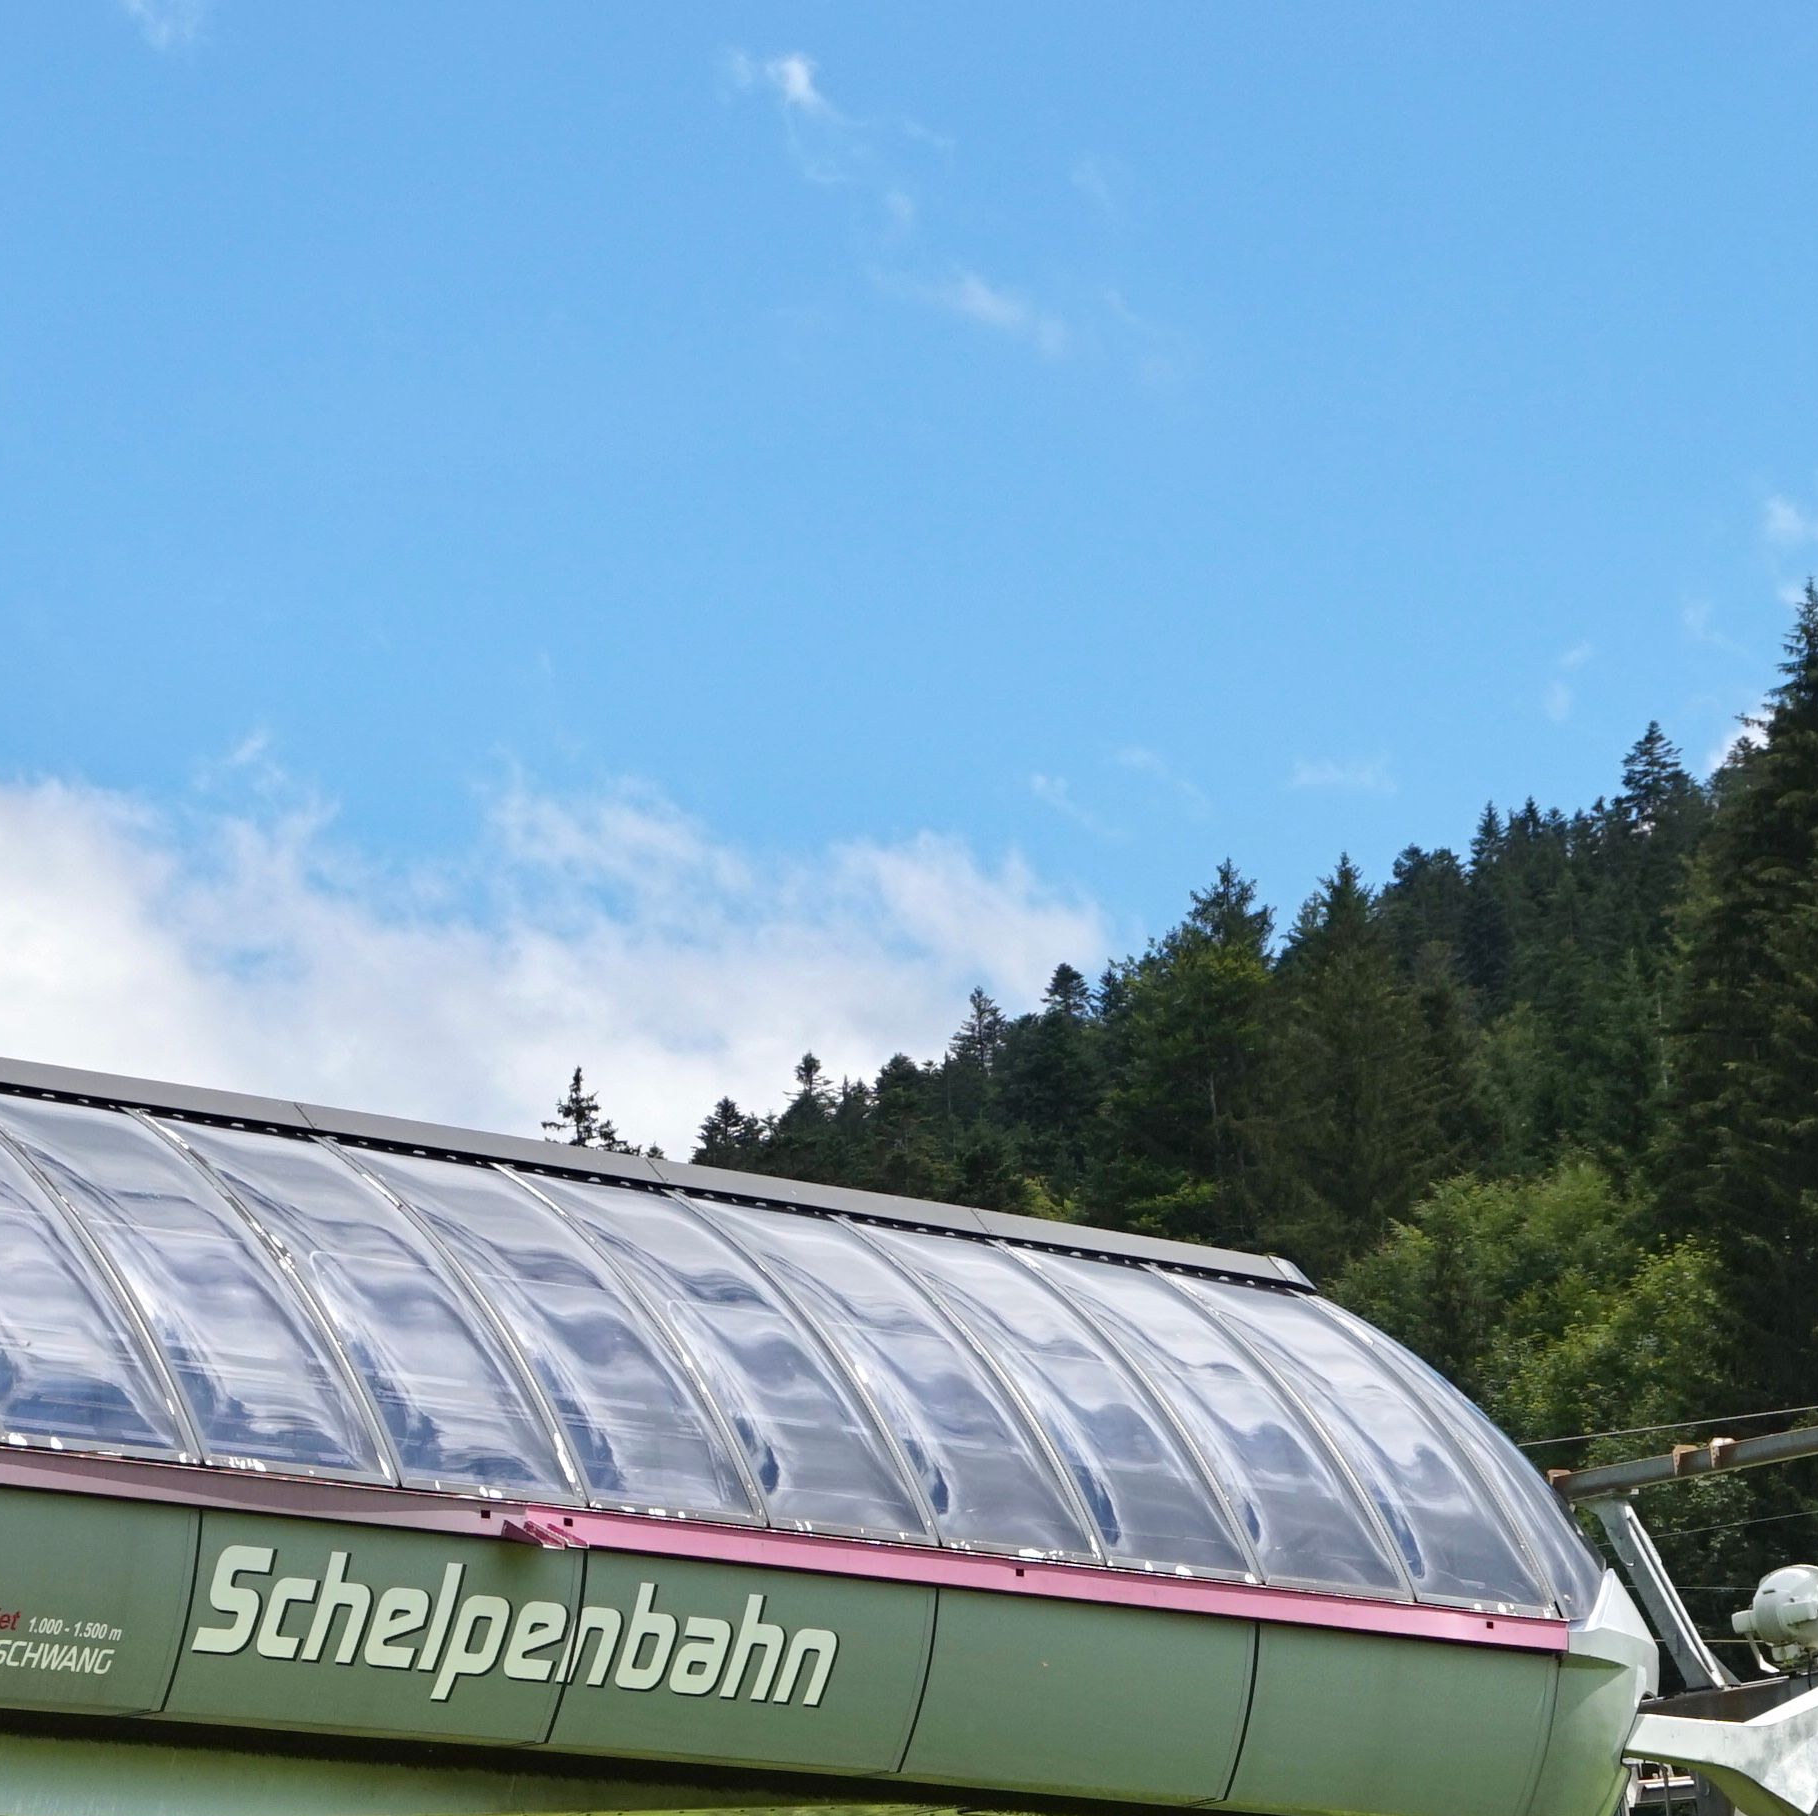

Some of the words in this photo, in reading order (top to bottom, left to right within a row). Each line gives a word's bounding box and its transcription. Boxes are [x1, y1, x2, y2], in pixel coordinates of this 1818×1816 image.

[28, 1616, 63, 1635] 1.000
[73, 1621, 108, 1640] 1.500
[108, 1627, 123, 1642] m
[192, 1545, 839, 1707] Schelpenbahn
